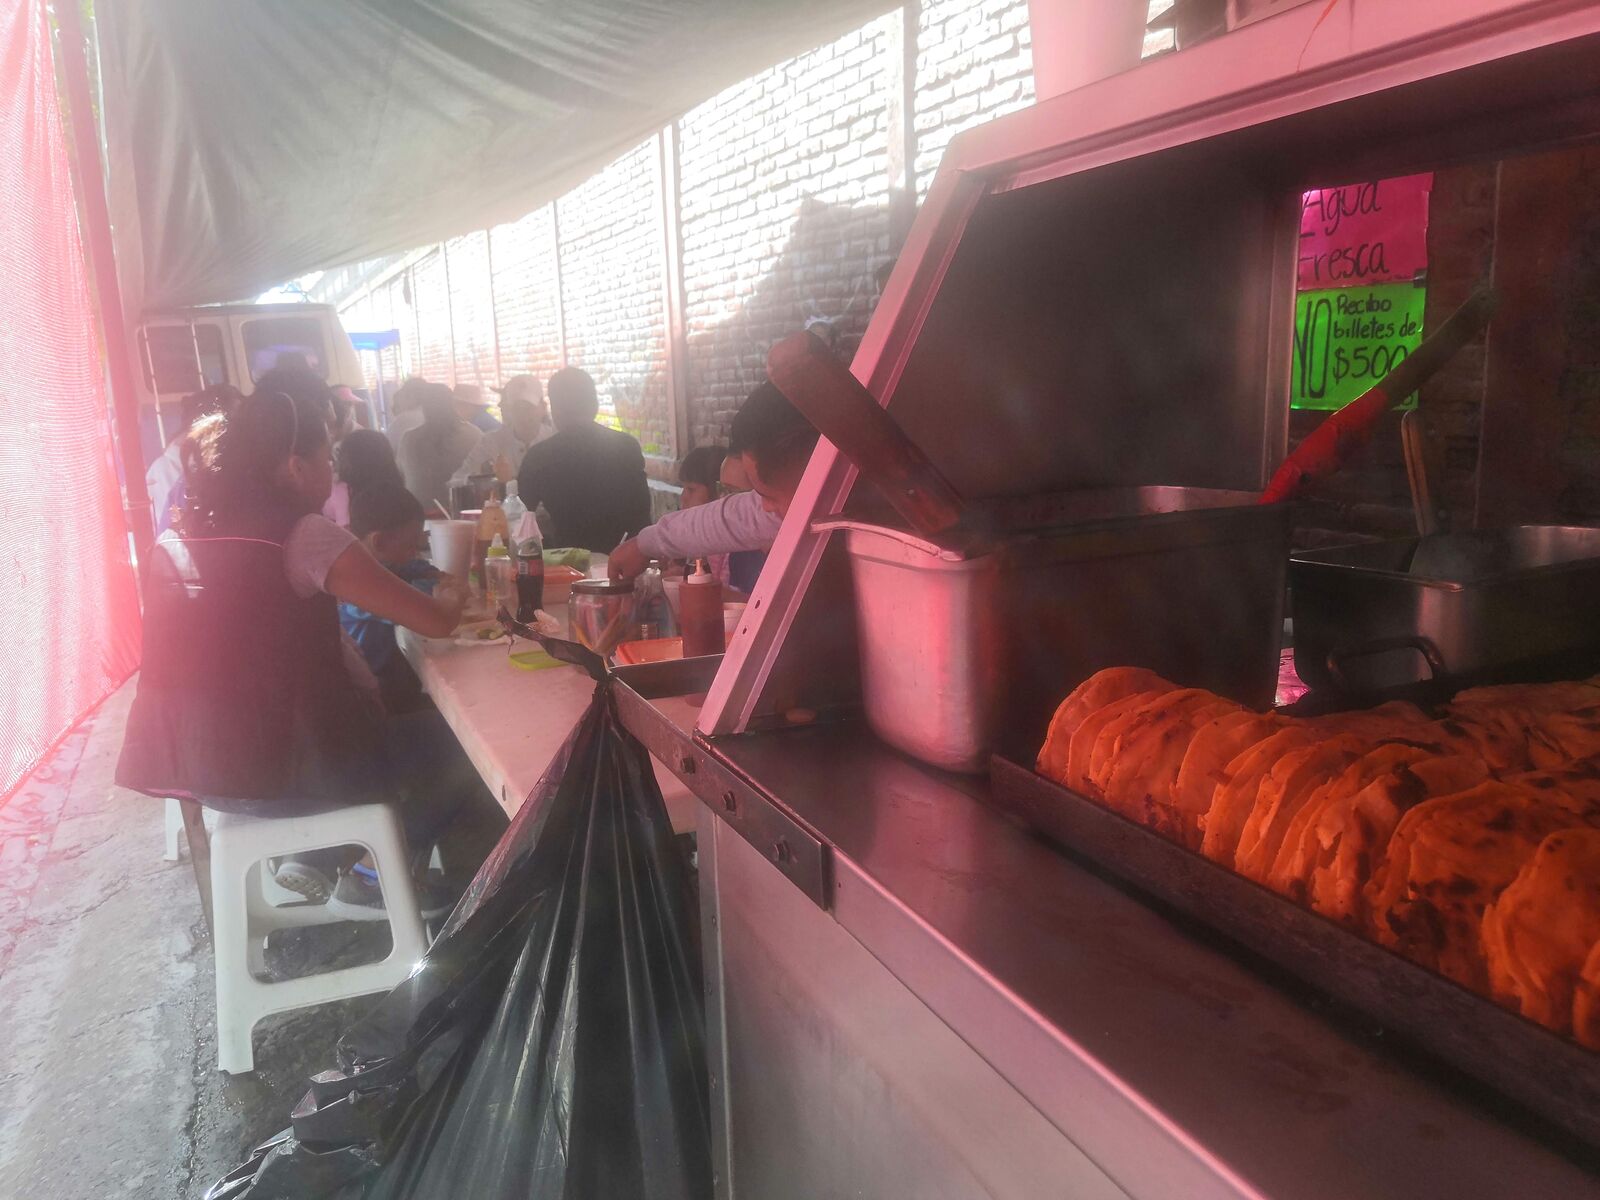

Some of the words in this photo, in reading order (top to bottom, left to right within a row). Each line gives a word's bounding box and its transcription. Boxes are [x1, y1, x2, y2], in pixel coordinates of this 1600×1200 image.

[1302, 182, 1381, 236] Agua
[1337, 294, 1392, 316] Recibo
[1334, 315, 1394, 339] billetes
[1399, 314, 1417, 337] de
